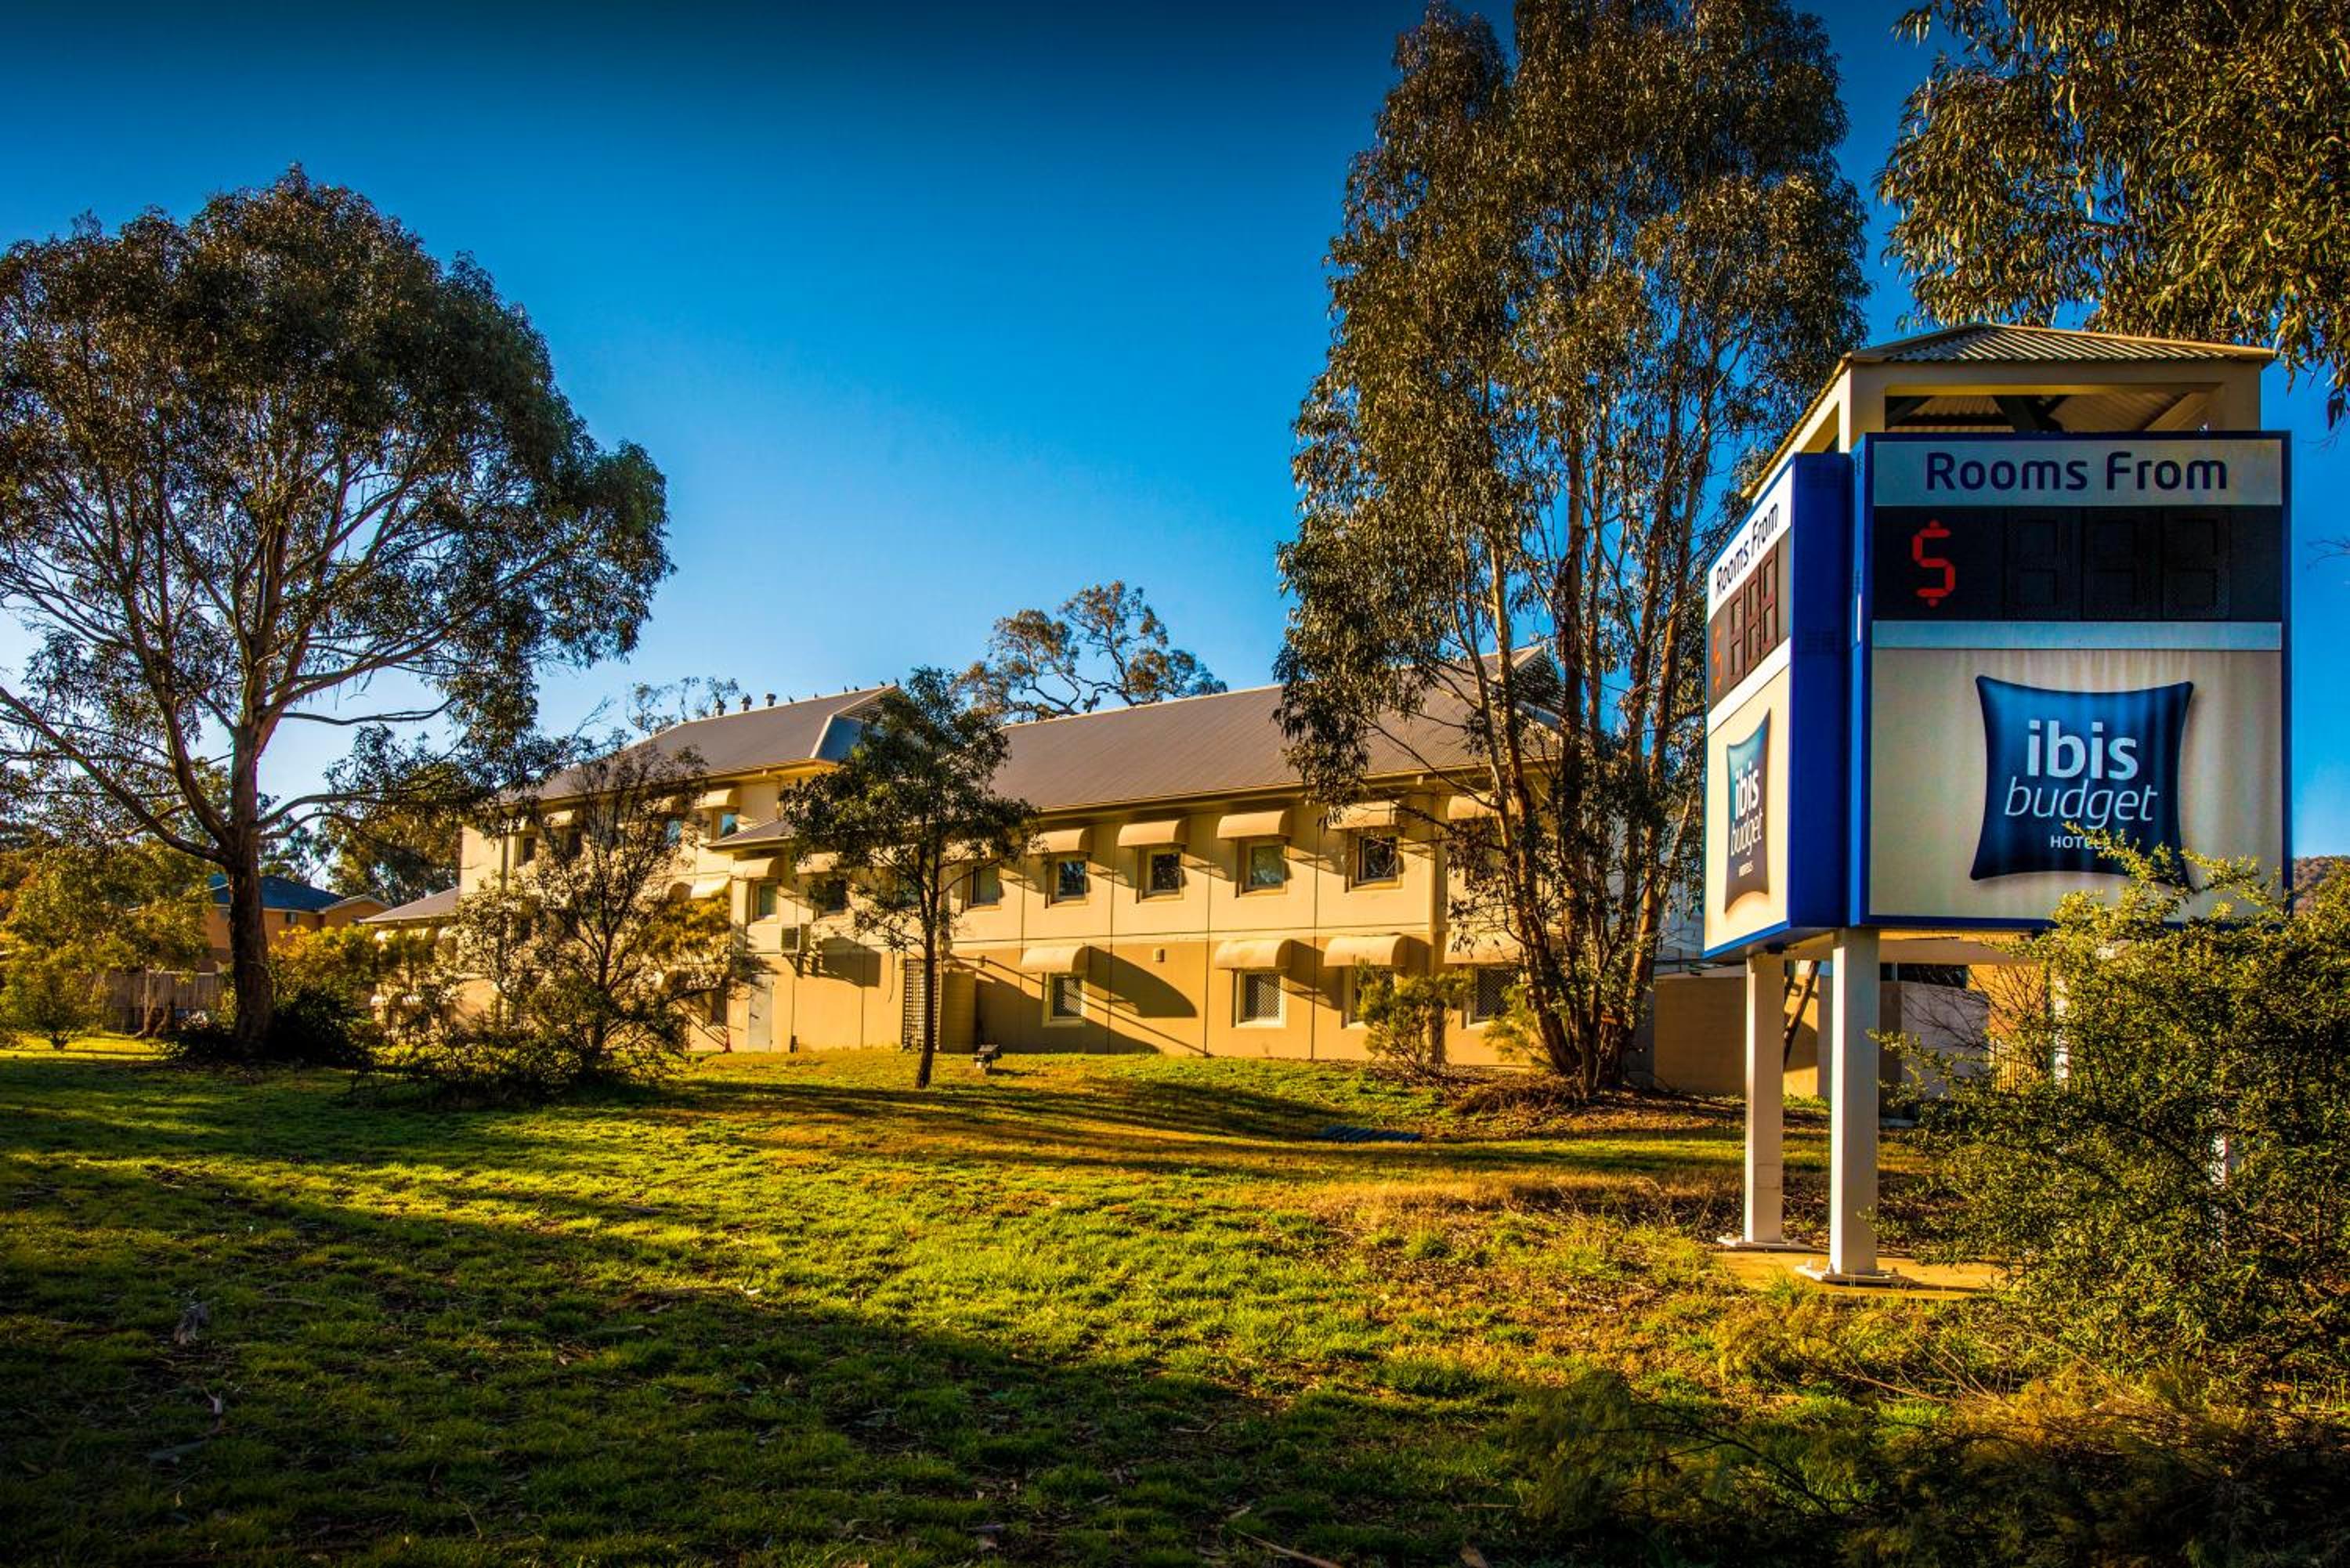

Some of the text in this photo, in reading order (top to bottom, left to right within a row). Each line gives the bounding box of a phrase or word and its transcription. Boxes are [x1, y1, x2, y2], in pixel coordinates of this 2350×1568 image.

[1926, 451, 2227, 491] Rooms From
[1715, 502, 1779, 599] Rooms From
[1911, 519, 1956, 607] $
[2026, 719, 2139, 781] ibis
[1734, 760, 1759, 820] ibis
[2005, 775, 2159, 829] budget
[1730, 807, 1763, 857] budget
[2049, 835, 2112, 851] HOTE
